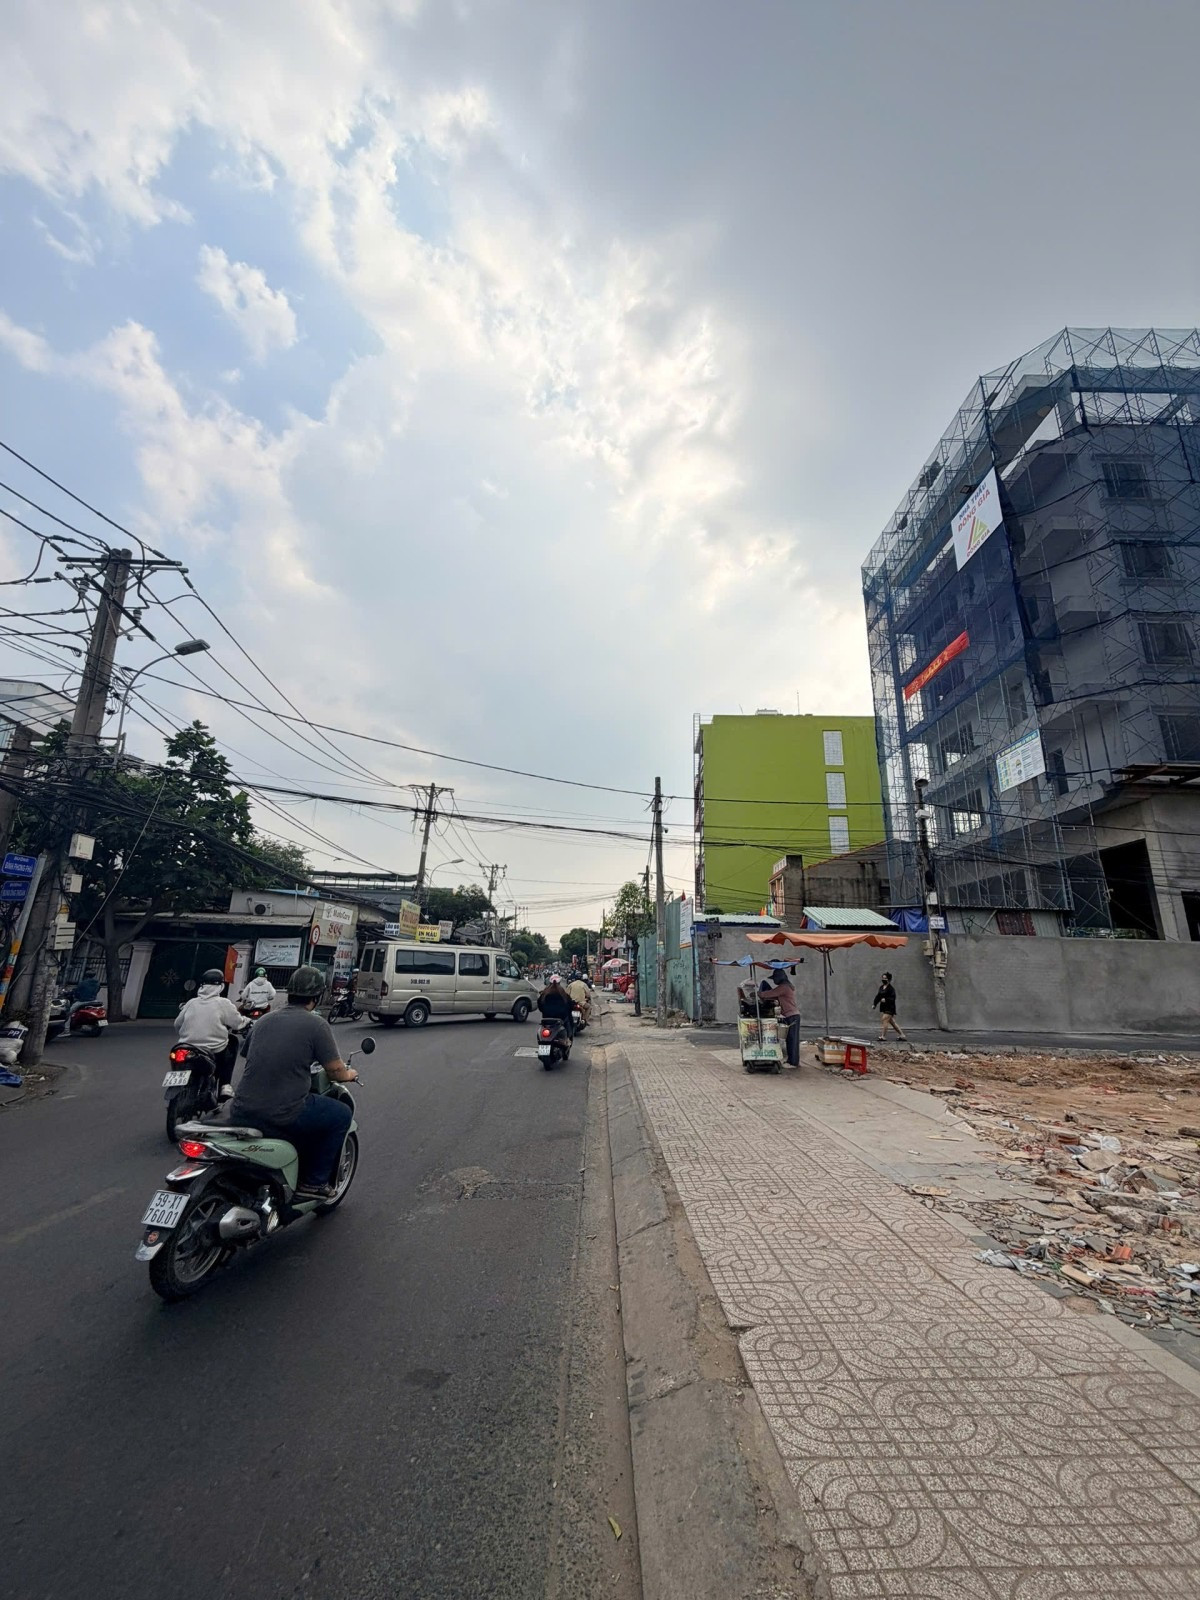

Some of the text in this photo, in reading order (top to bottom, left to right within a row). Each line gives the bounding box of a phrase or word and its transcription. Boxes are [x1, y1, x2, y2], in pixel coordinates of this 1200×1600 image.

[977, 489, 991, 507] GIA
[980, 529, 991, 541] GIA
[155, 1193, 183, 1210] 59-X1
[144, 1208, 180, 1226] 760.01
